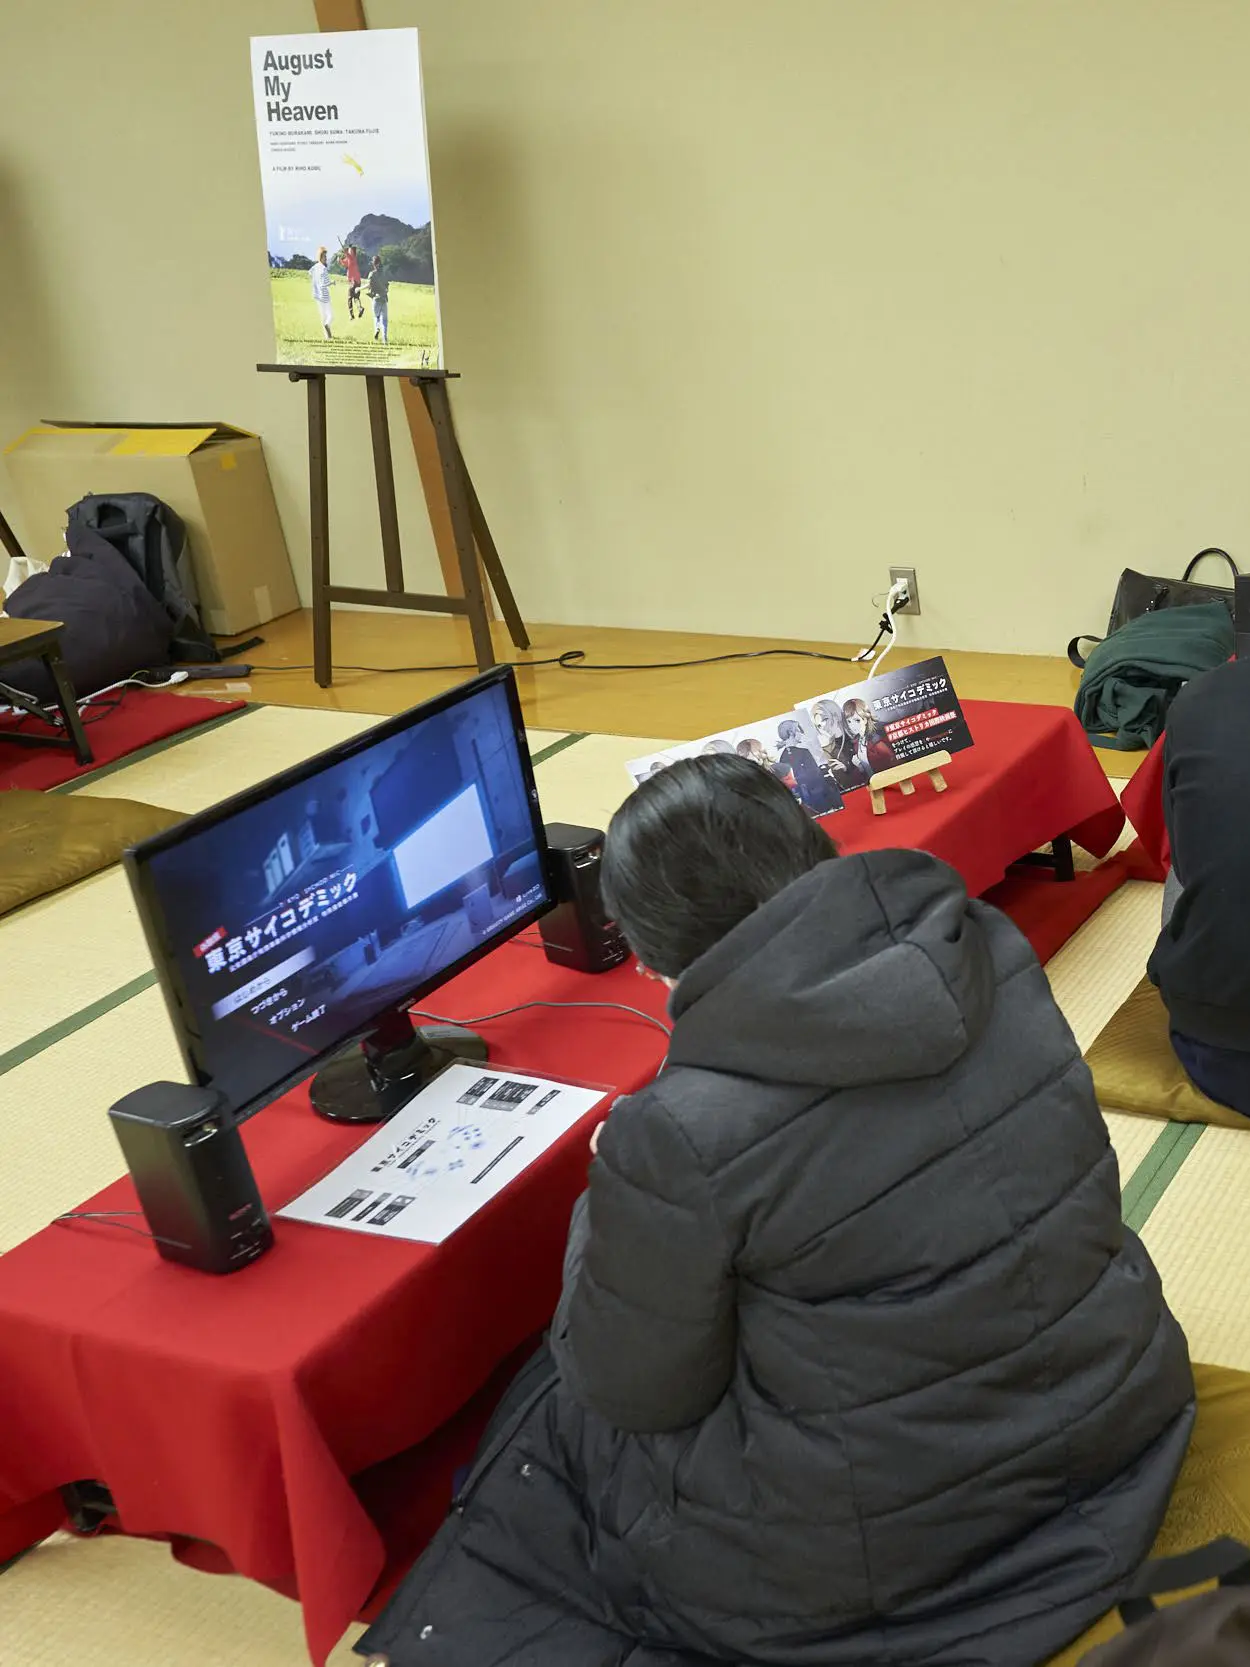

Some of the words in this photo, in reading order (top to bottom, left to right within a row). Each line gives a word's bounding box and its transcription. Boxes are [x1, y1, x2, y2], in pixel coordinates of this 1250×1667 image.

[263, 48, 334, 76] August
[264, 75, 292, 103] My
[266, 101, 339, 122] Heaven
[872, 677, 947, 711] 東京サイコデミック
[204, 872, 358, 974] 東京サイコデミック
[269, 998, 306, 1025] オプション
